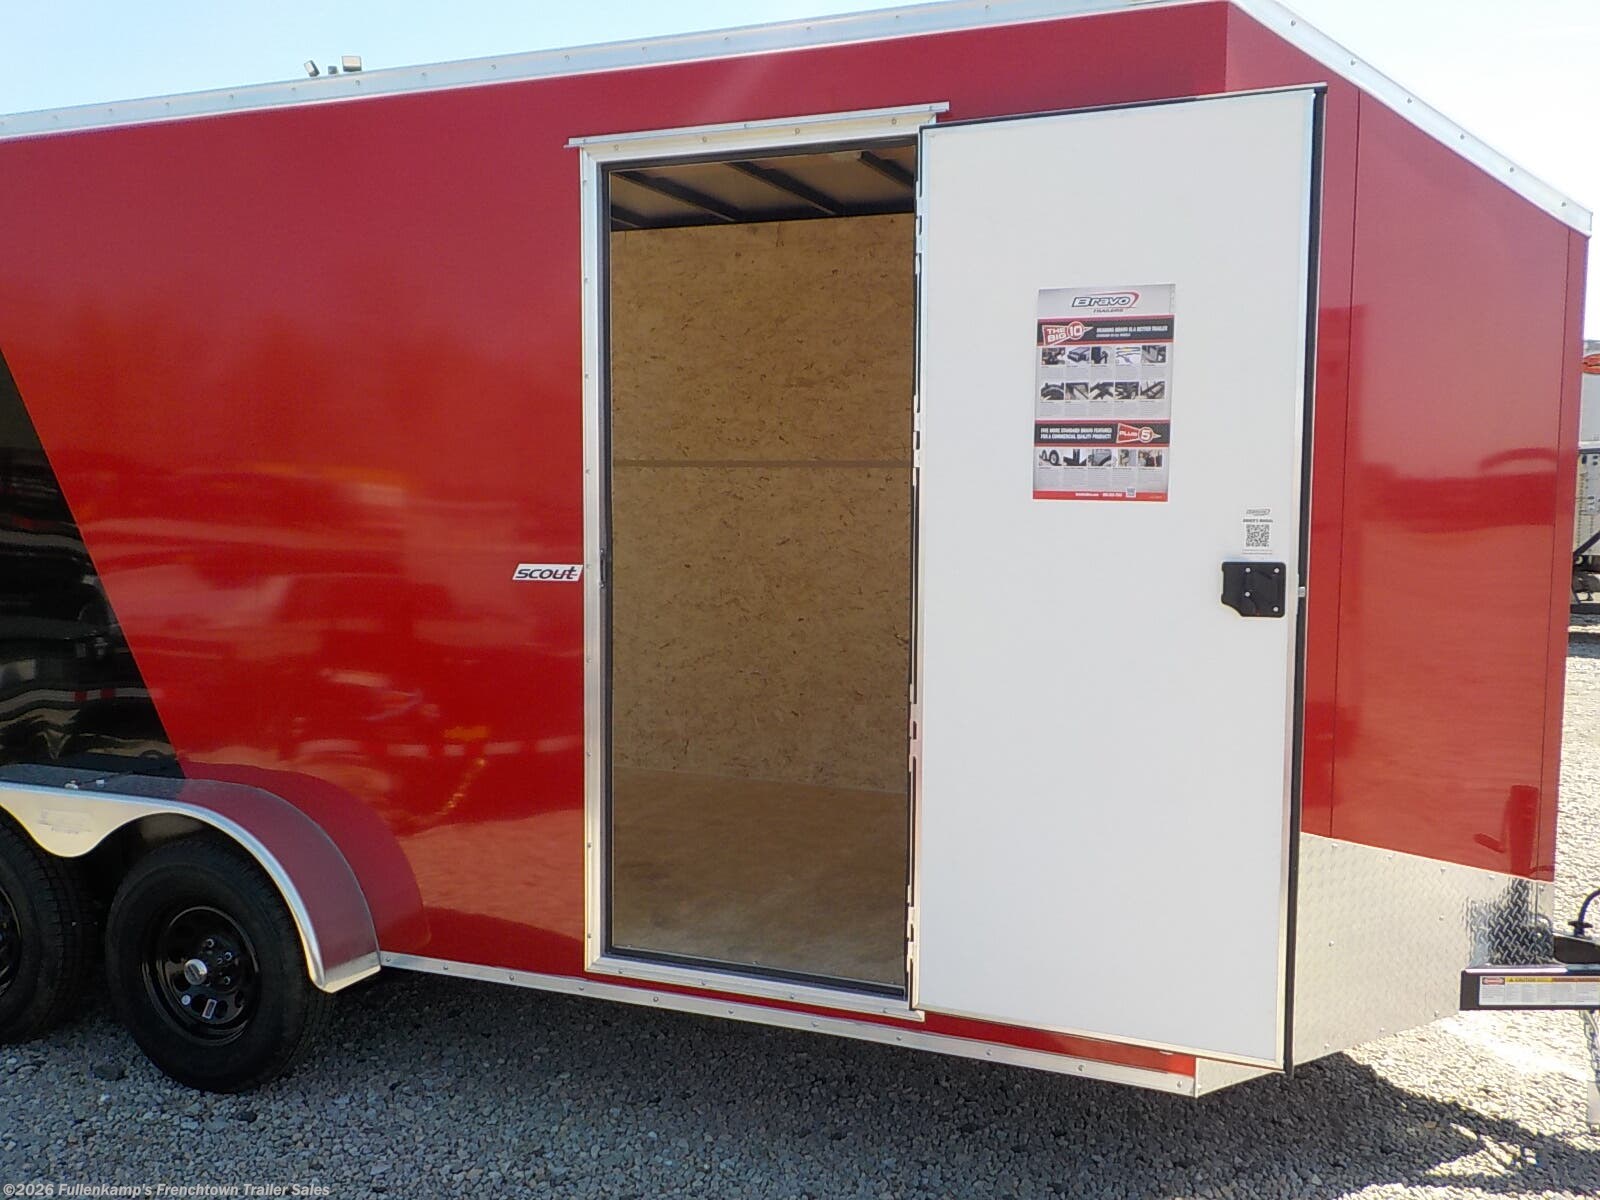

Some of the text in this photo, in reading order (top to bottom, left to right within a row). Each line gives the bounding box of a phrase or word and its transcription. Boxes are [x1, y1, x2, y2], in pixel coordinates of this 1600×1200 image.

[1072, 296, 1131, 307] Bravo
[1070, 325, 1083, 337] 10
[1048, 333, 1067, 342] BIG
[1141, 429, 1151, 440] 5
[515, 566, 578, 580] scout
